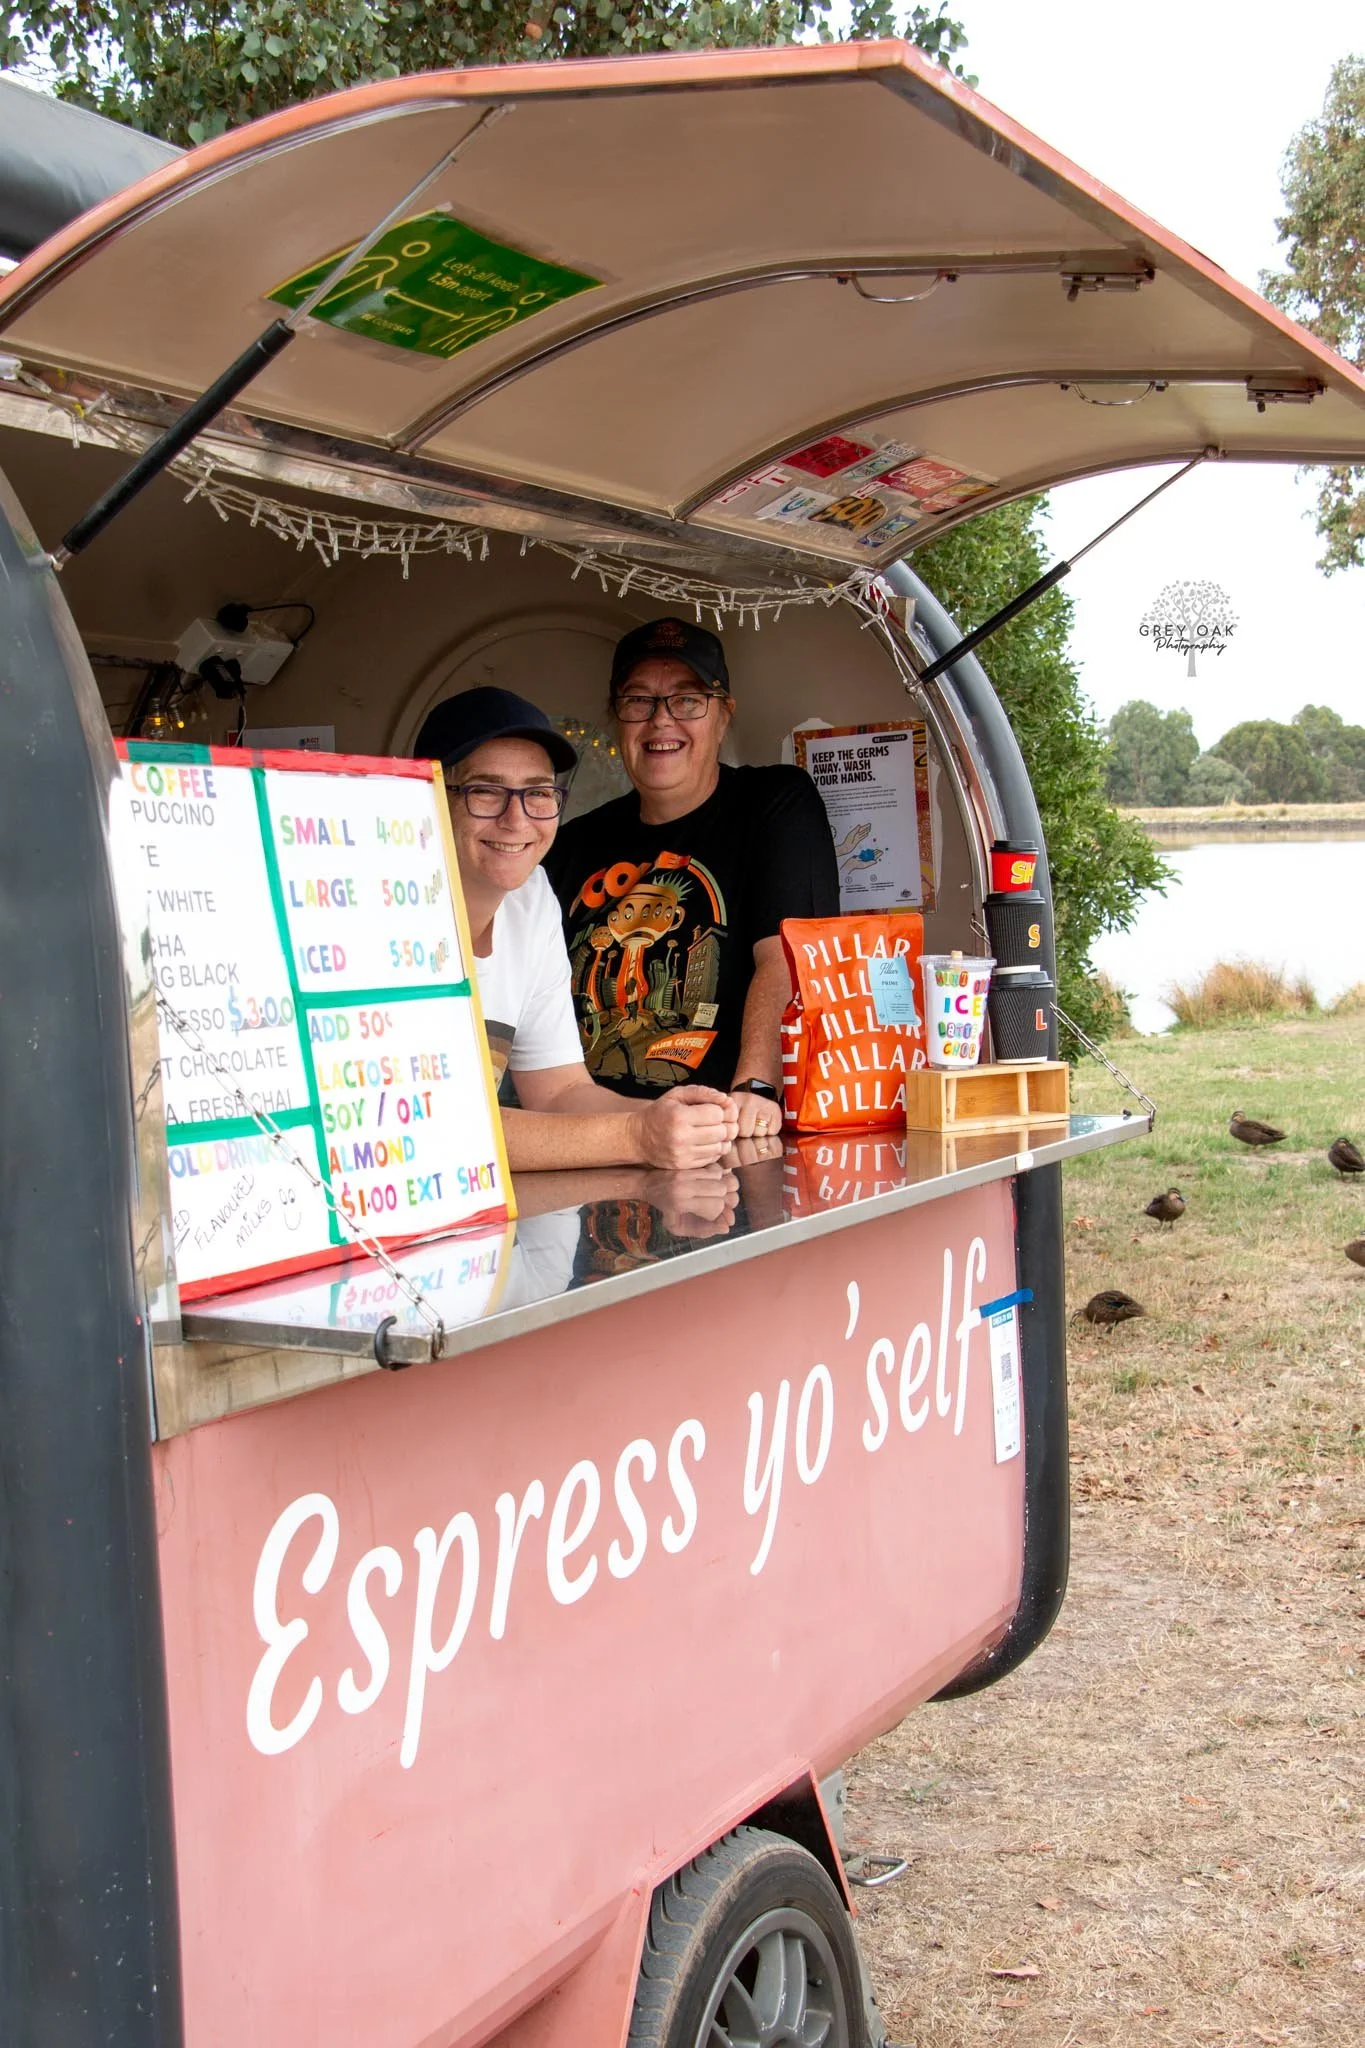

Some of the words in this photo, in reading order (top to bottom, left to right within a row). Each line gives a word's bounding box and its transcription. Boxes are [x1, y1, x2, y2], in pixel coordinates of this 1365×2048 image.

[426, 272, 461, 291] 1.5m
[455, 284, 494, 301] apart
[488, 275, 520, 292] keep
[812, 751, 835, 764] KEEP
[838, 748, 854, 761] THE
[856, 745, 890, 759] GERMS
[844, 760, 871, 772] WASH
[130, 763, 217, 798] COFFEE
[813, 774, 839, 787] YOUR
[841, 770, 876, 784] HANDS.
[130, 800, 215, 826] PUCCINO
[280, 815, 355, 846] SMALL
[156, 889, 216, 913] WHITE
[289, 878, 358, 908] LARGE
[1028, 924, 1041, 948] S
[299, 944, 346, 974] ICED
[802, 933, 911, 970] PILLAR
[179, 963, 241, 987] BLACK
[935, 970, 969, 988] MINT
[310, 1014, 350, 1043] ADD
[1036, 1008, 1048, 1031] L
[180, 1046, 288, 1078] CHOCOLATE
[317, 1055, 404, 1091] LACTOSE
[410, 1053, 451, 1082] FREE
[817, 1042, 927, 1080] PILLAR
[251, 1088, 292, 1115] CHAI
[322, 1098, 366, 1133] SOY
[377, 1092, 386, 1127] /
[397, 1091, 432, 1125] OAT
[168, 1145, 213, 1178] OLD
[329, 1135, 416, 1175] ALMOND
[406, 1172, 443, 1206] EXT
[456, 1162, 496, 1195] SHOT
[245, 1418, 706, 1769] Espress
[742, 1236, 988, 1577] yo'self
